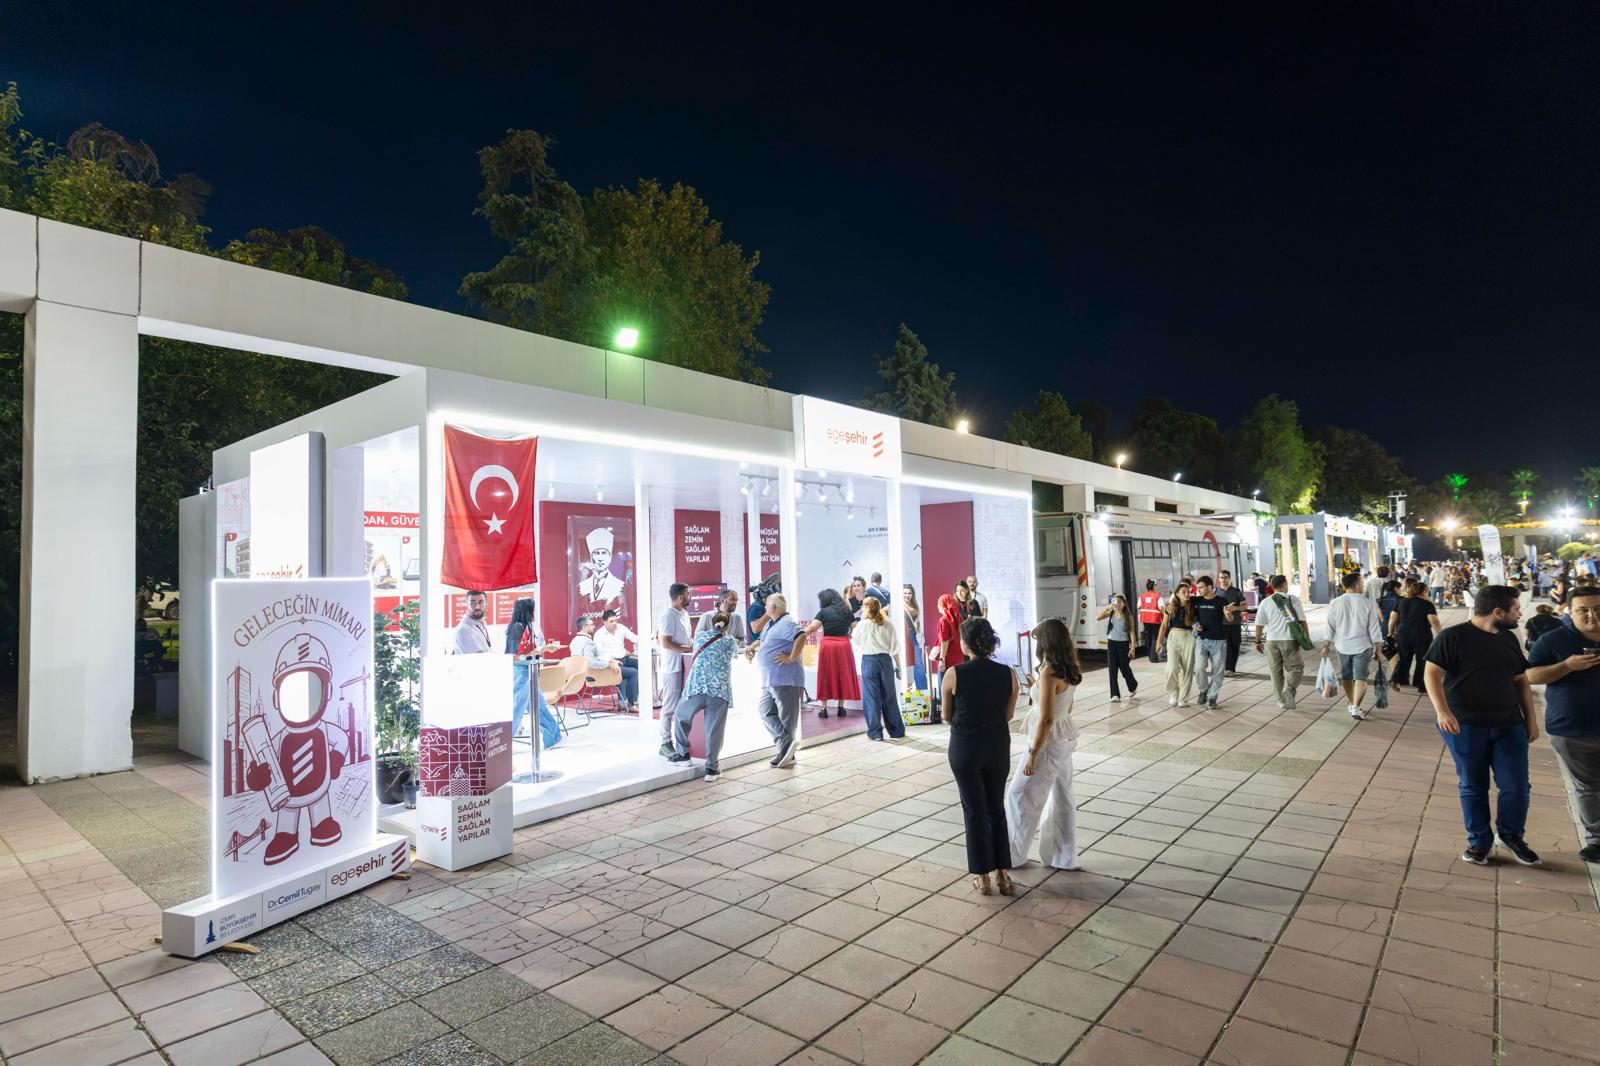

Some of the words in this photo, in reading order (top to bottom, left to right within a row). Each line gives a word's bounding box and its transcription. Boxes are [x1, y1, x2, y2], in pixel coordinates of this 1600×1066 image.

[684, 525, 710, 534] SAĞLAM
[684, 534, 704, 543] ZEMİN
[684, 543, 711, 553] SAĞLAM
[685, 555, 710, 563] YAPILAR
[233, 593, 319, 648] GELECEĞİN
[321, 599, 367, 641] MİMARI
[457, 798, 491, 814] SAĞLAM
[457, 810, 482, 824] ZEMİN
[457, 818, 491, 833] SAĞLAM
[457, 827, 490, 843] YAPILAR
[330, 854, 387, 886] egeşehir
